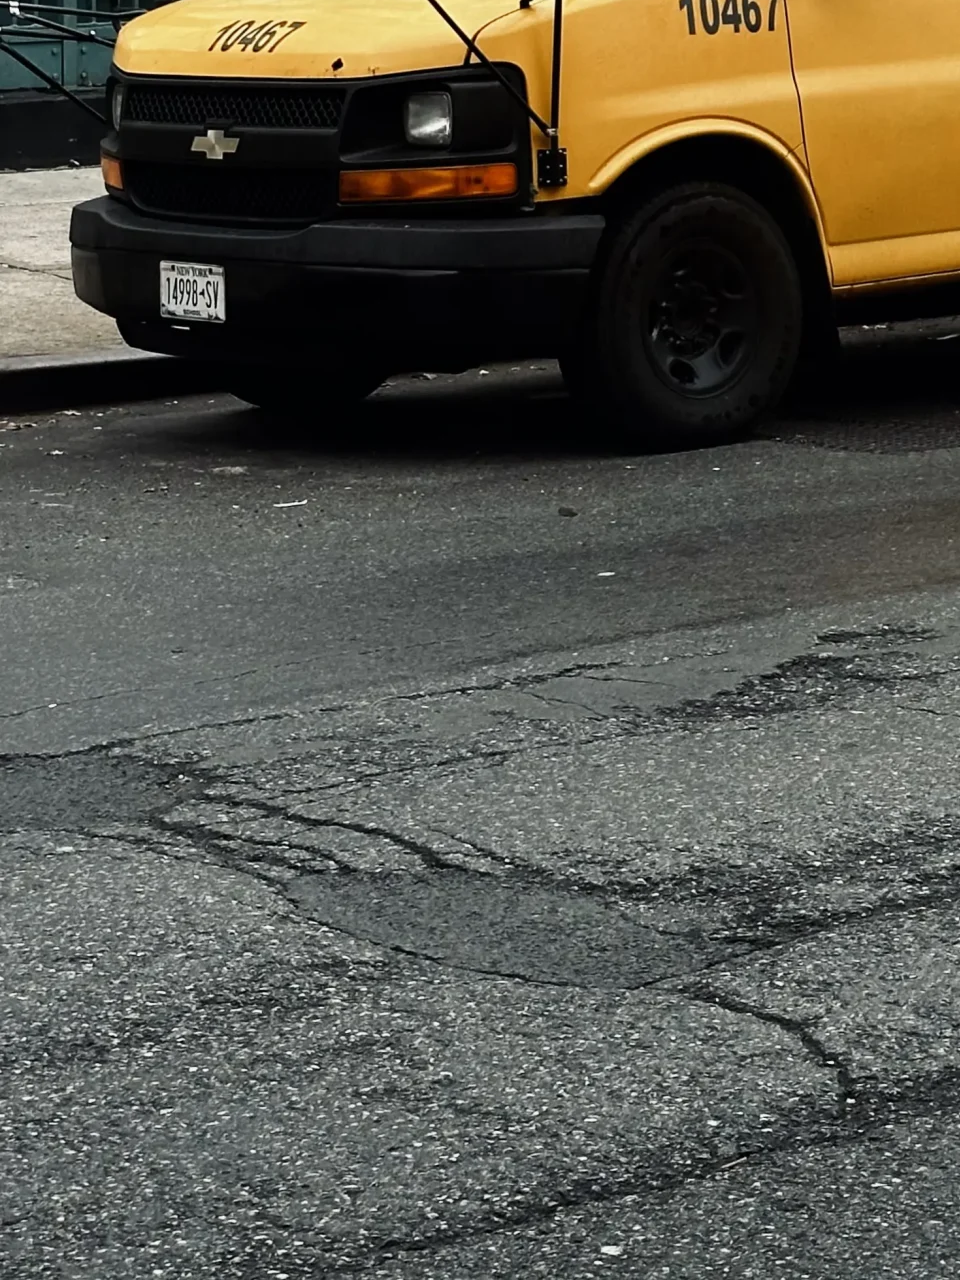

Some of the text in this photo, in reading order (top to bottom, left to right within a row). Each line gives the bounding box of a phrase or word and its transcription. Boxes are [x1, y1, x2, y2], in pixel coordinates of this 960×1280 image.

[208, 20, 307, 53] 10467
[176, 266, 209, 277] NEW YORK
